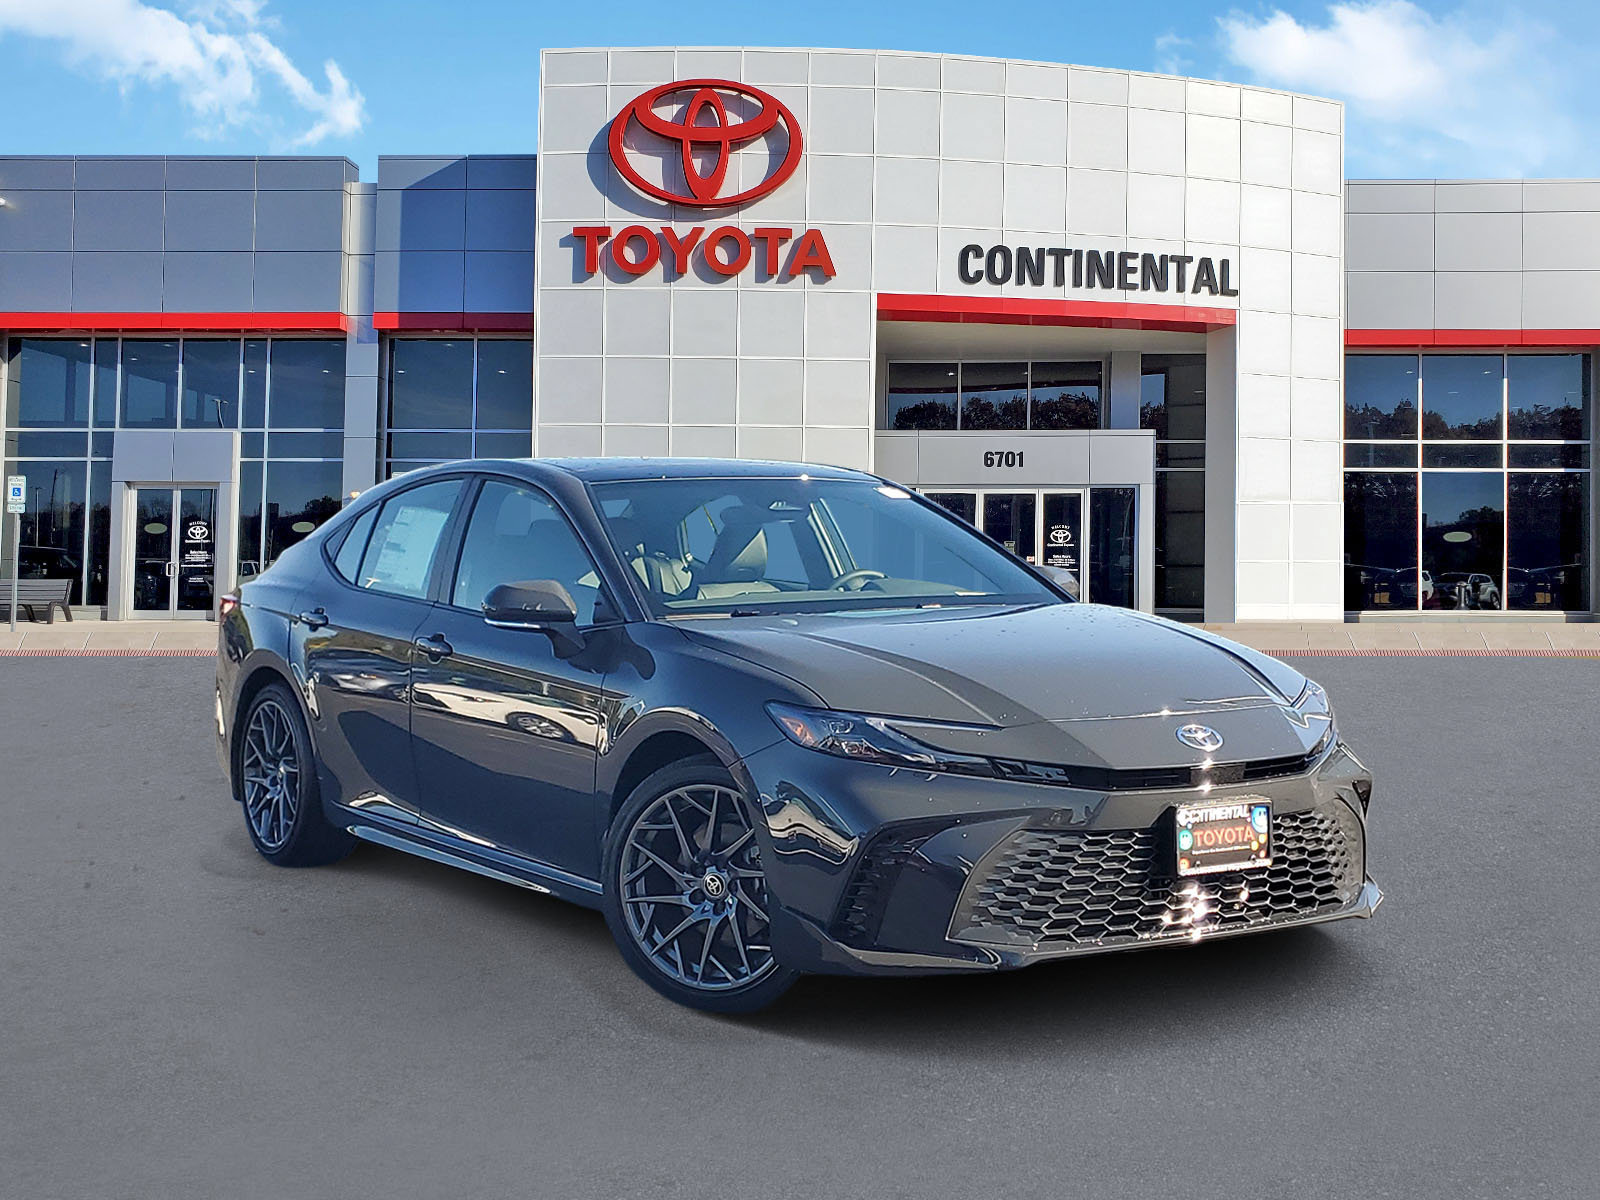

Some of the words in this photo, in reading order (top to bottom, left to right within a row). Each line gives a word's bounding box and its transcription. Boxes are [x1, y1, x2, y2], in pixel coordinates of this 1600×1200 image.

[573, 225, 836, 277] TOYOTA
[958, 244, 1239, 296] CONTINENTAL
[983, 451, 1024, 468] 6701
[1176, 804, 1250, 827] CONTINENTAL
[1193, 826, 1256, 847] TOYOTA
